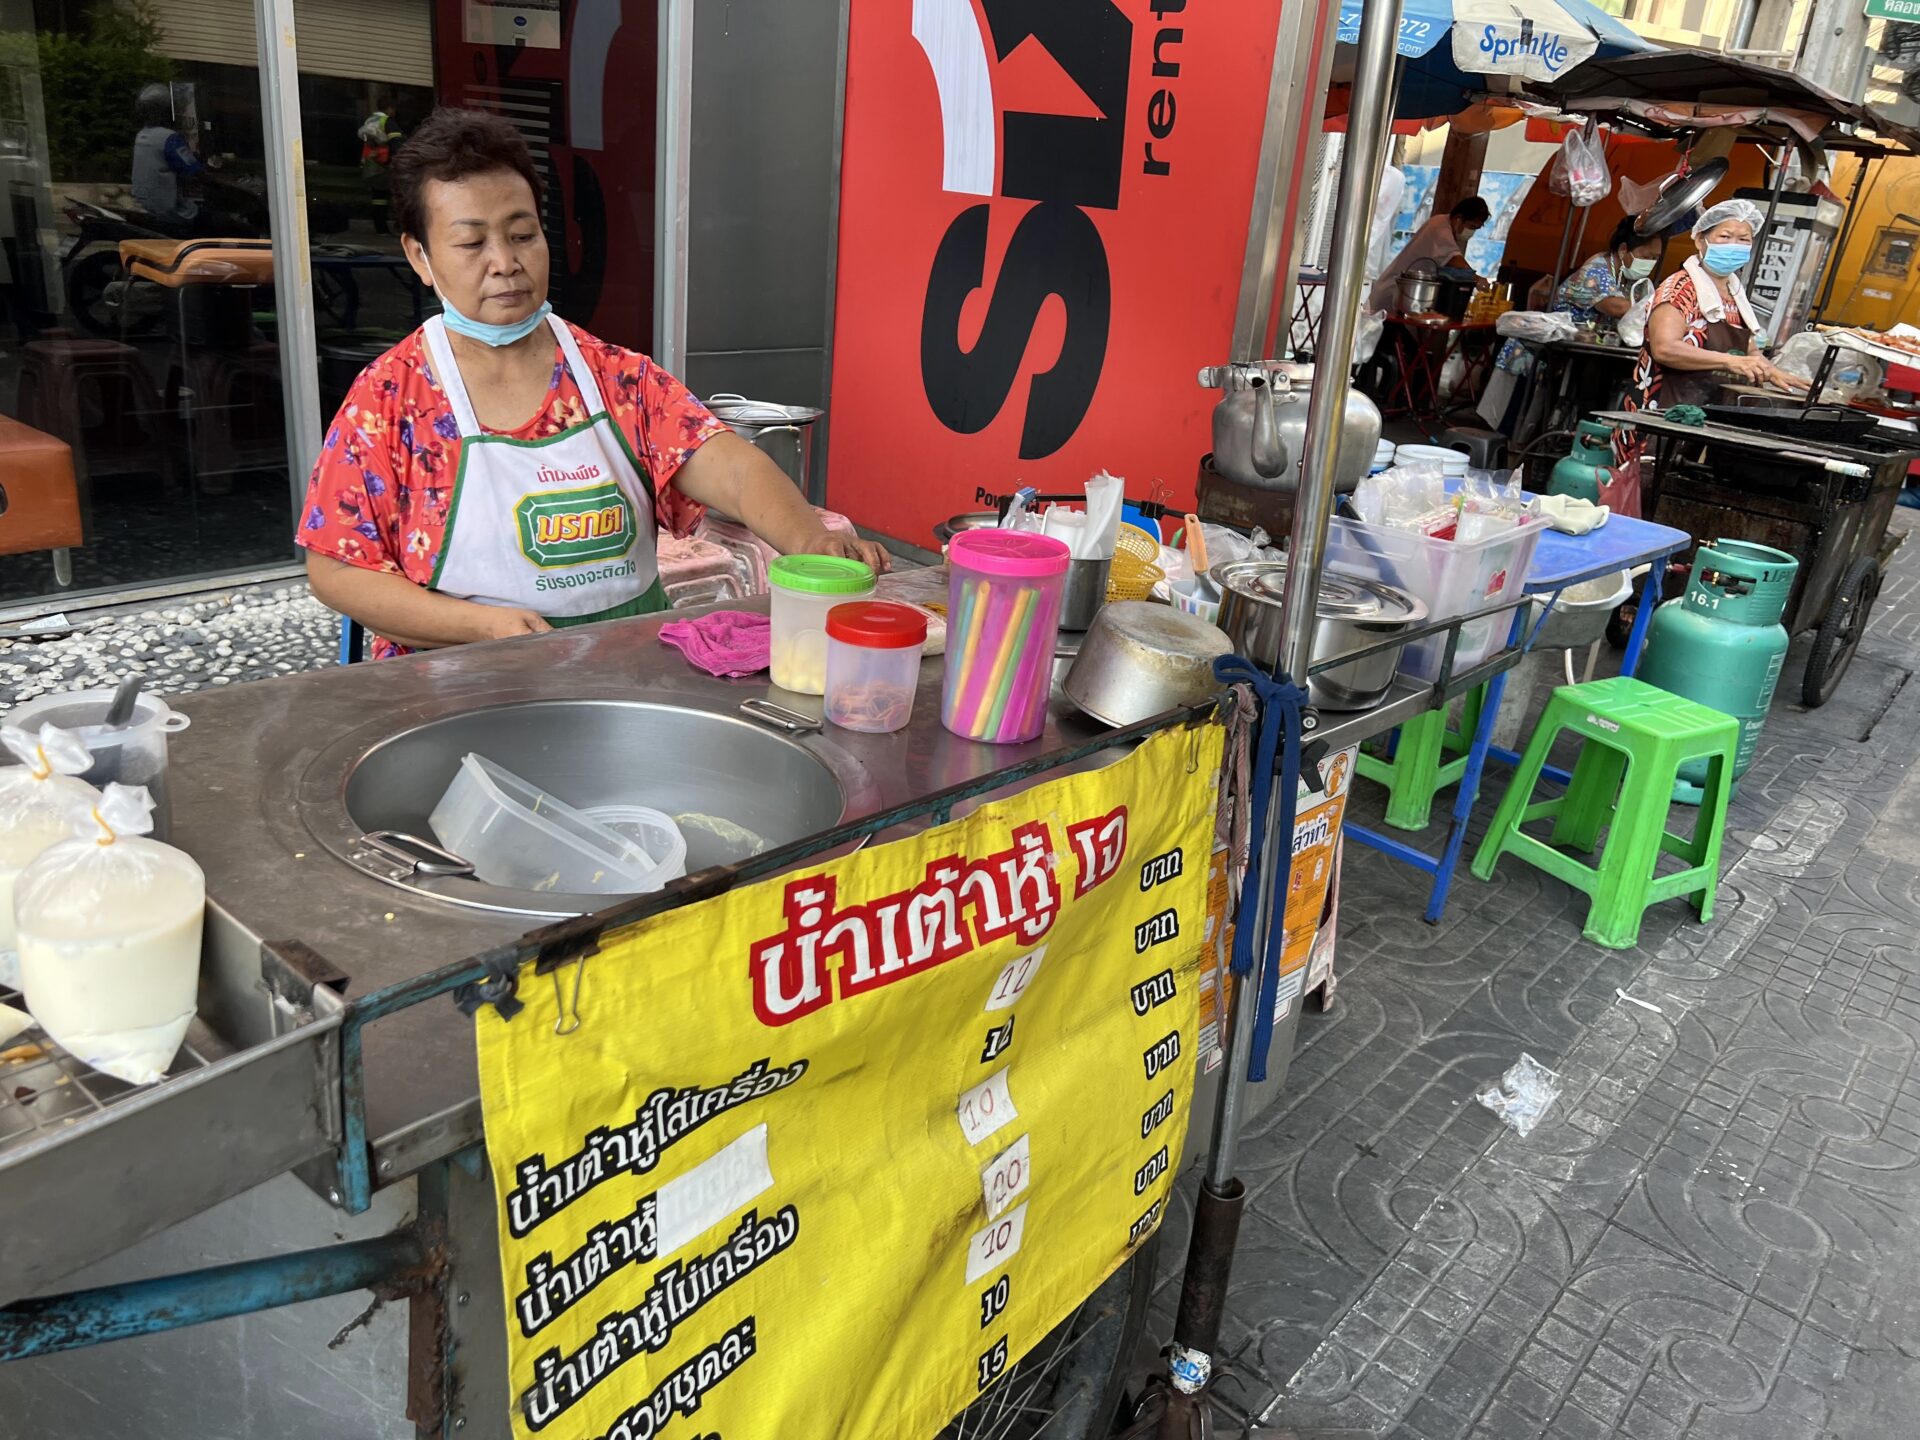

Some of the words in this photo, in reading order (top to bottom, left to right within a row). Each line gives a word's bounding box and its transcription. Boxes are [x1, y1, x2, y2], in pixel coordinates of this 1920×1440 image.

[1479, 24, 1568, 72] Sprnkle
[536, 463, 601, 483] นำมนพืช
[537, 505, 623, 544] มรกต
[535, 559, 637, 592] รับรองจะติดใจ
[1690, 590, 1720, 610] 16.1
[1141, 850, 1181, 888] บาท
[760, 833, 1055, 1015] น้ำเต้าหู้
[1136, 910, 1177, 951] บาท
[995, 955, 1033, 1001] 12
[1132, 971, 1174, 1013] บาท
[985, 1017, 1013, 1059] 12
[1145, 1033, 1180, 1077] บาท
[963, 1087, 994, 1131] 10
[1142, 1090, 1174, 1136] บาท
[509, 1062, 804, 1232] น้ำเต้าหู้ใส่เครื่อง
[1136, 1147, 1168, 1193] บาท
[981, 1220, 1012, 1260] 10
[1129, 1200, 1161, 1244] บาท
[520, 1200, 658, 1331] น้ำเต้าหู้
[527, 1209, 797, 1425] น้ำเต้าหู้ไม่เครื่อง
[983, 1278, 1008, 1323] 10
[980, 1340, 1006, 1386] 15
